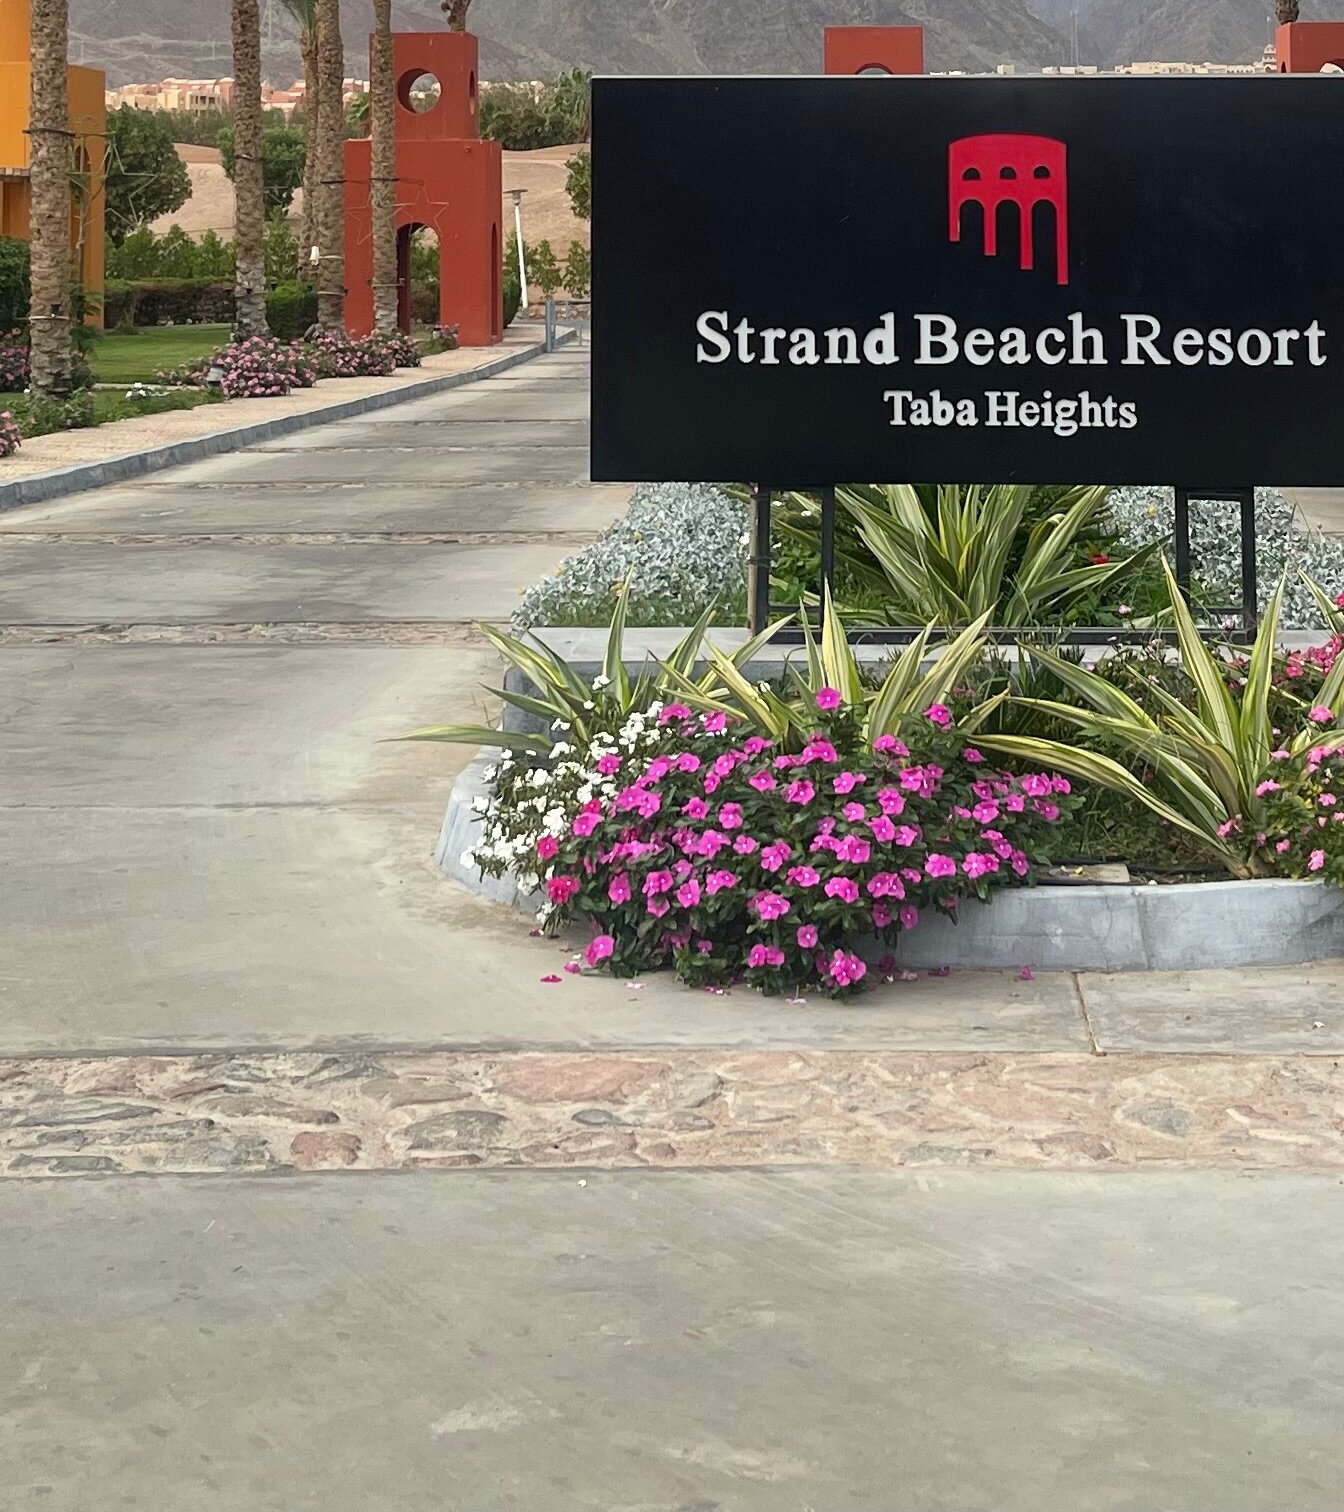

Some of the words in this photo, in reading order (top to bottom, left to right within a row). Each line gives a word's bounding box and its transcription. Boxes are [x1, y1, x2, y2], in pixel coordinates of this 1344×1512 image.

[696, 310, 900, 365] Strand
[913, 311, 1109, 366] Beach
[1120, 314, 1327, 366] Resort
[883, 389, 979, 427] Taba
[984, 390, 1138, 437] Heights
